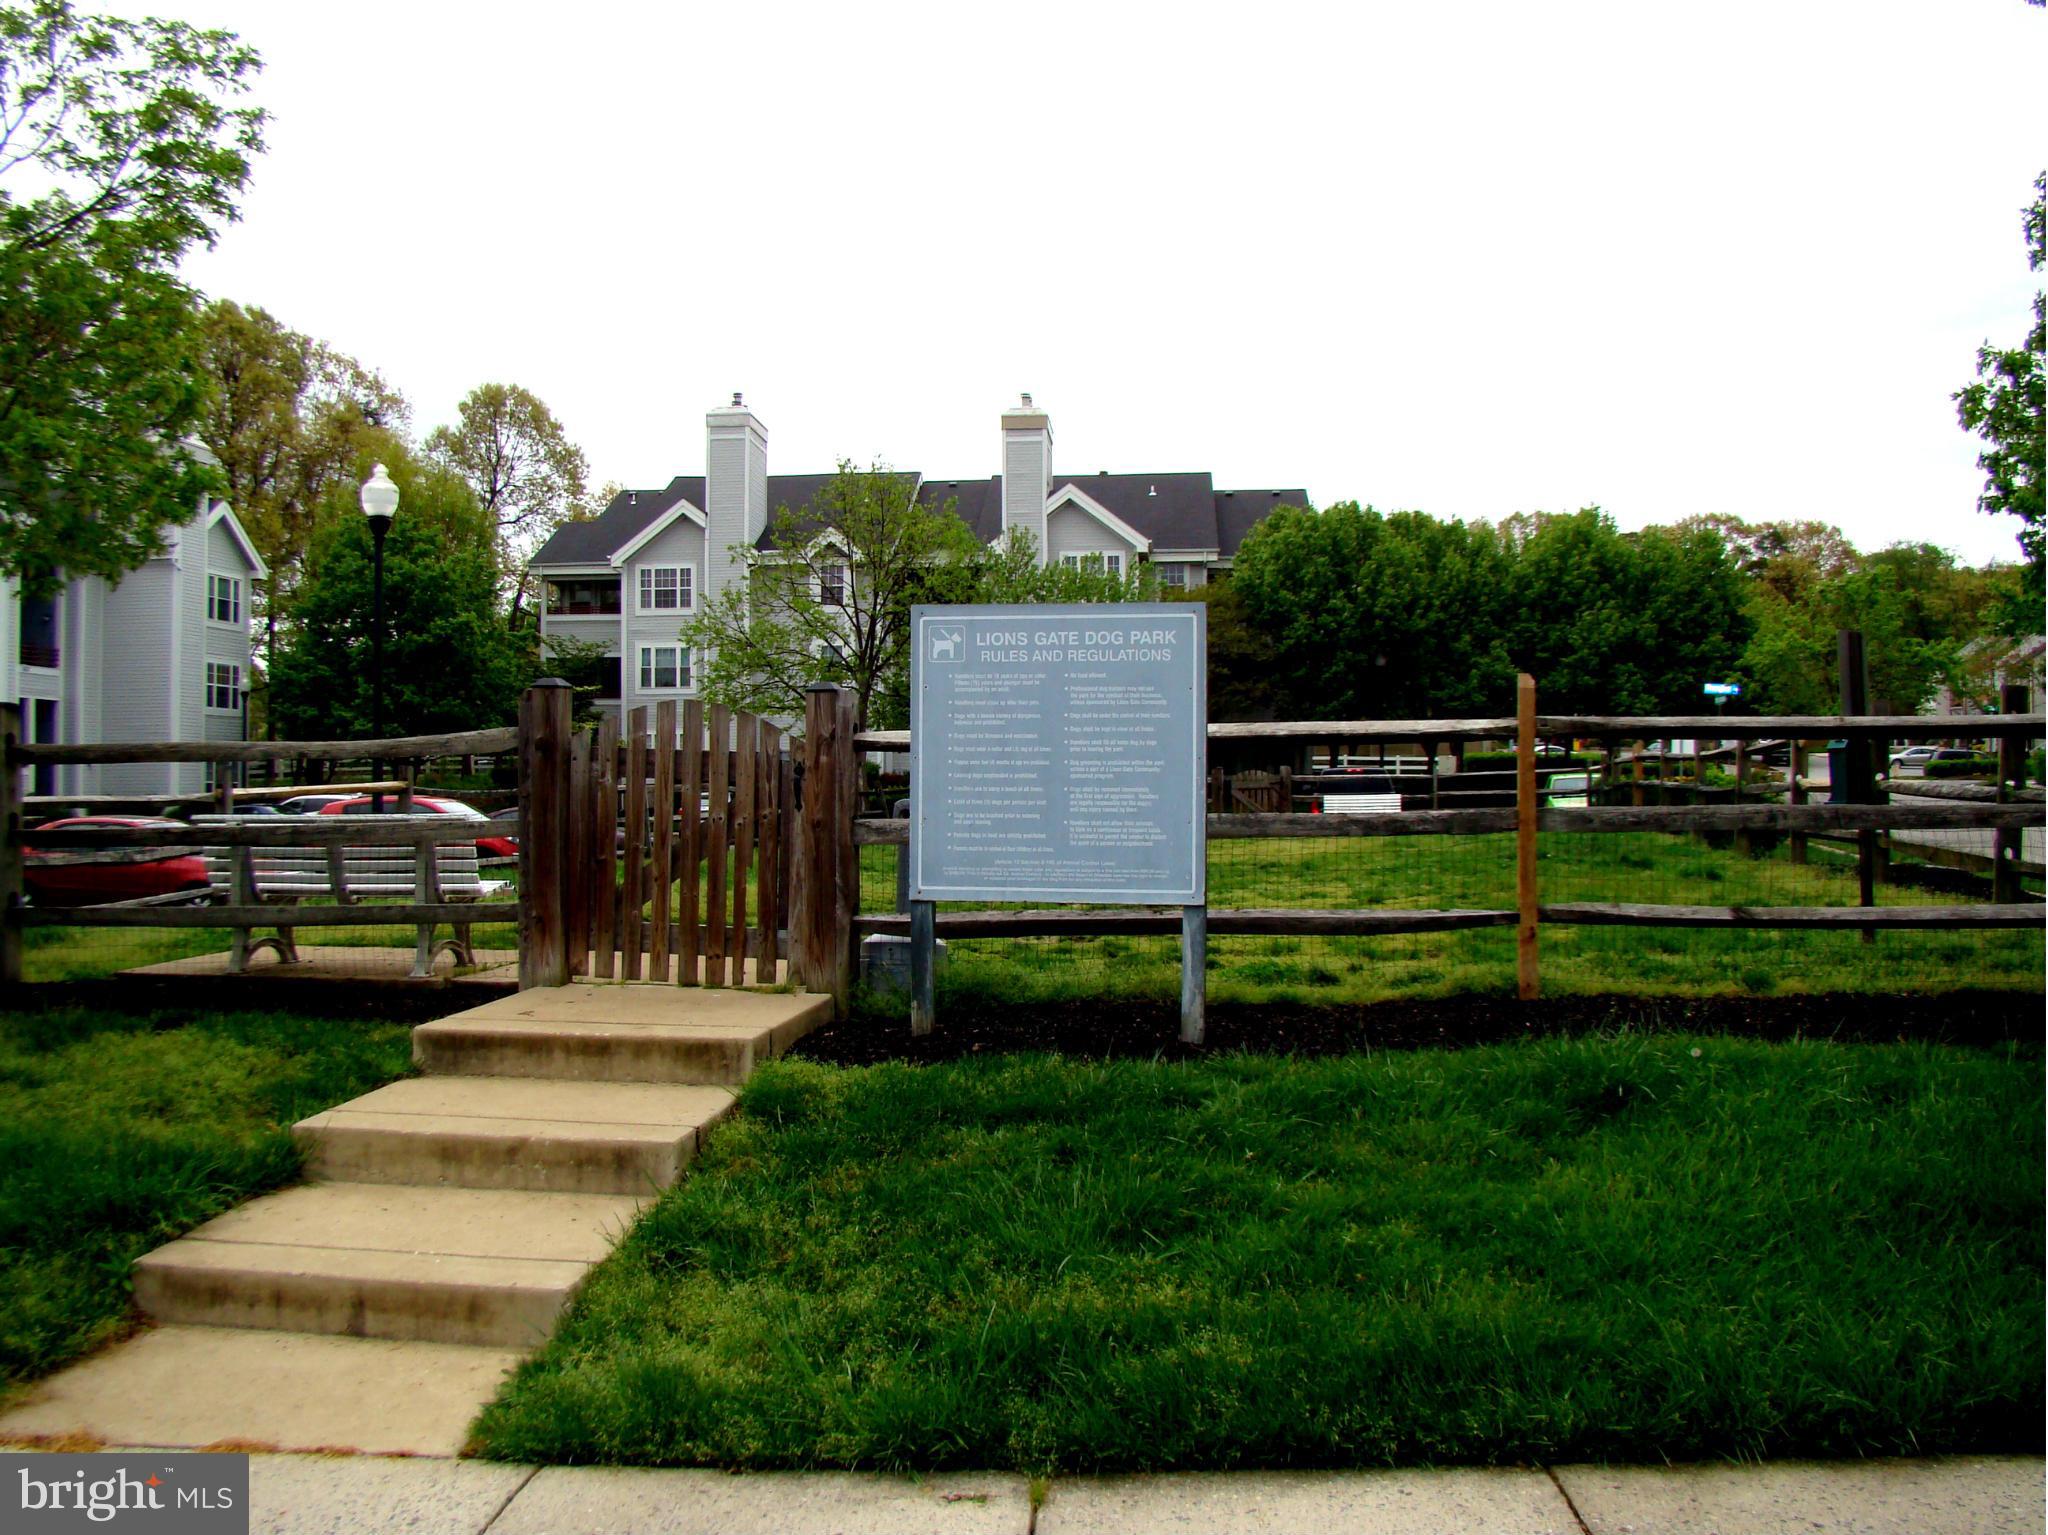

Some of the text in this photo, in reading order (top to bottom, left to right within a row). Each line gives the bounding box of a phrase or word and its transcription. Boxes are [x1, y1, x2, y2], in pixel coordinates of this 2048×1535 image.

[976, 630, 1177, 646] LIONS GATE DOG PARK
[981, 648, 1172, 662] RULES AND REGULATIONS
